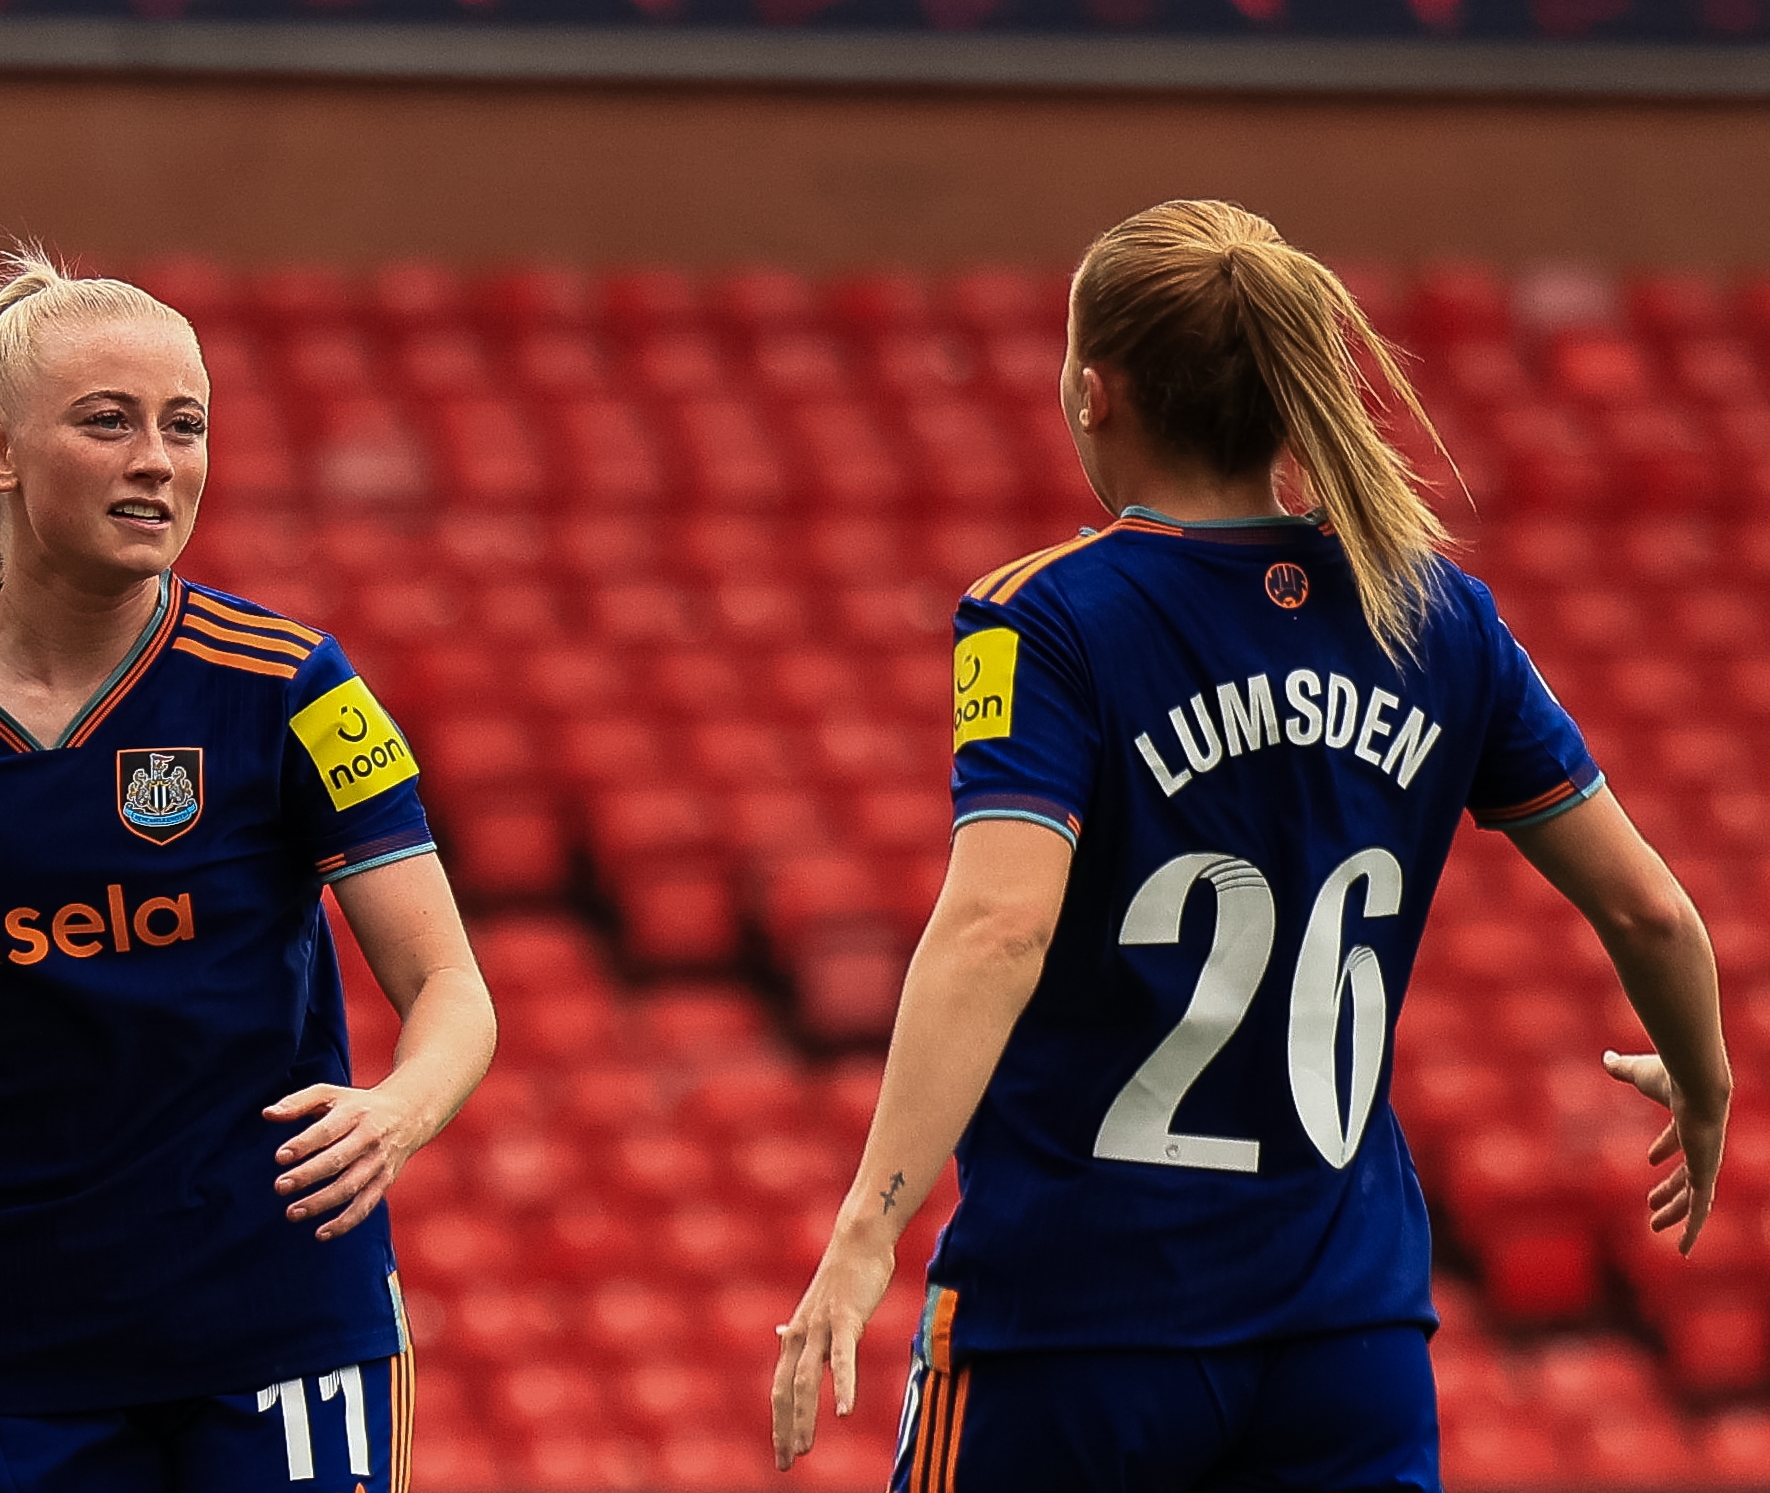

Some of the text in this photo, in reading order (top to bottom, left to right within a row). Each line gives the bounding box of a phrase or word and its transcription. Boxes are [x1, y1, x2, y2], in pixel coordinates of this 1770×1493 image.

[955, 695, 1003, 732] oon
[1134, 668, 1442, 797] LUMSDEN
[328, 738, 405, 790] noon
[4, 884, 195, 966] sela
[1092, 846, 1404, 1174] 26
[257, 1364, 371, 1482] 11
